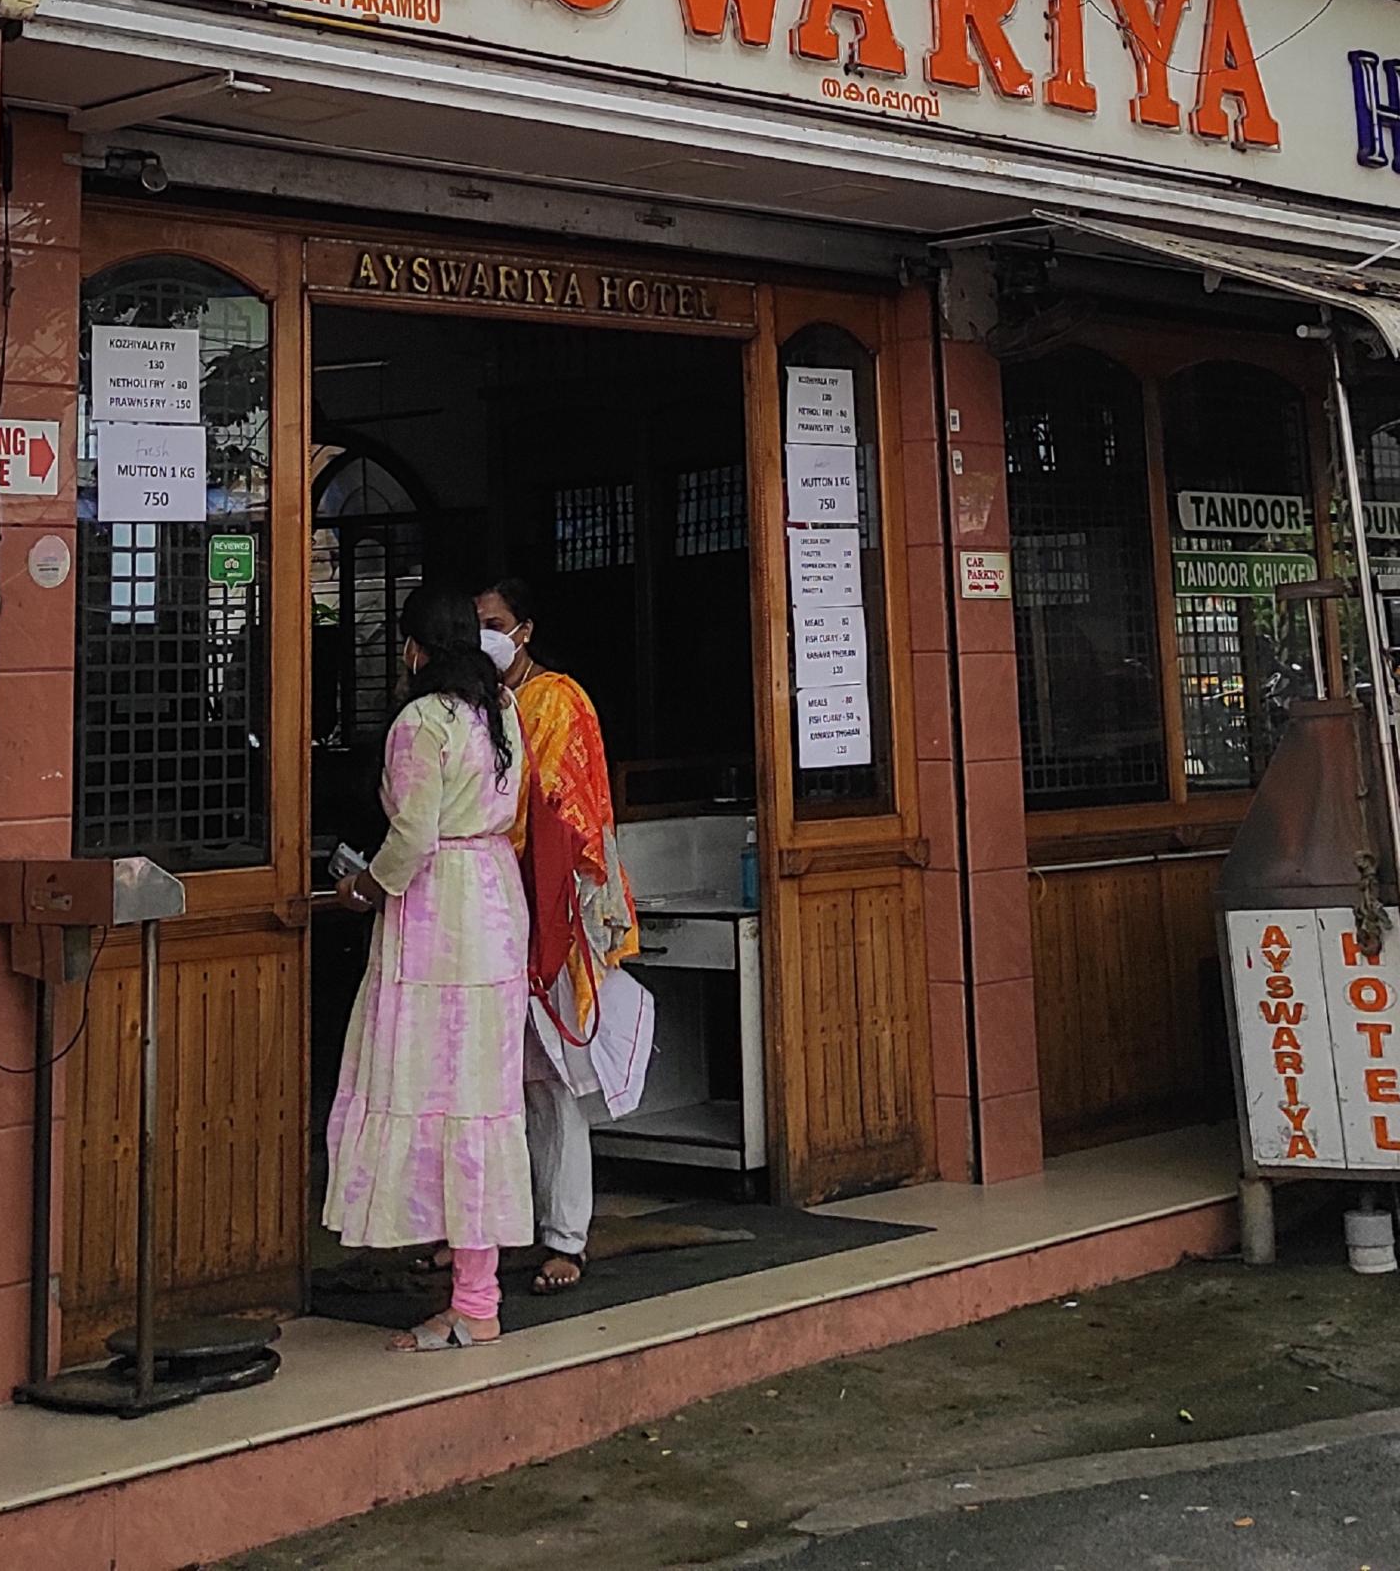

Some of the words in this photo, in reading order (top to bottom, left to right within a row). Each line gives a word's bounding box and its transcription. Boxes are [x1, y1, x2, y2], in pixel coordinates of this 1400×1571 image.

[357, 252, 584, 307] AYSWARIYA
[600, 276, 717, 318] HOTEL
[109, 338, 158, 351] KOZHIYALA
[160, 341, 176, 351] FRY
[149, 380, 166, 389] FRY
[109, 397, 148, 408] PRAWNS
[150, 399, 167, 408] FRY
[117, 465, 167, 478] MUTTON
[170, 467, 177, 478] 1
[180, 467, 195, 478] KG
[801, 478, 833, 487] MUTTON
[840, 476, 850, 486] KG
[143, 492, 169, 506] 750
[818, 498, 835, 510] 750
[1190, 495, 1301, 529] TANDOOR
[966, 556, 985, 568] CAR
[967, 569, 1005, 582] PARKING
[1177, 561, 1250, 588] TANDOOR
[804, 619, 825, 627] MEALS
[808, 698, 827, 708] MEALS
[1259, 925, 1317, 1159] AYSWARIYA
